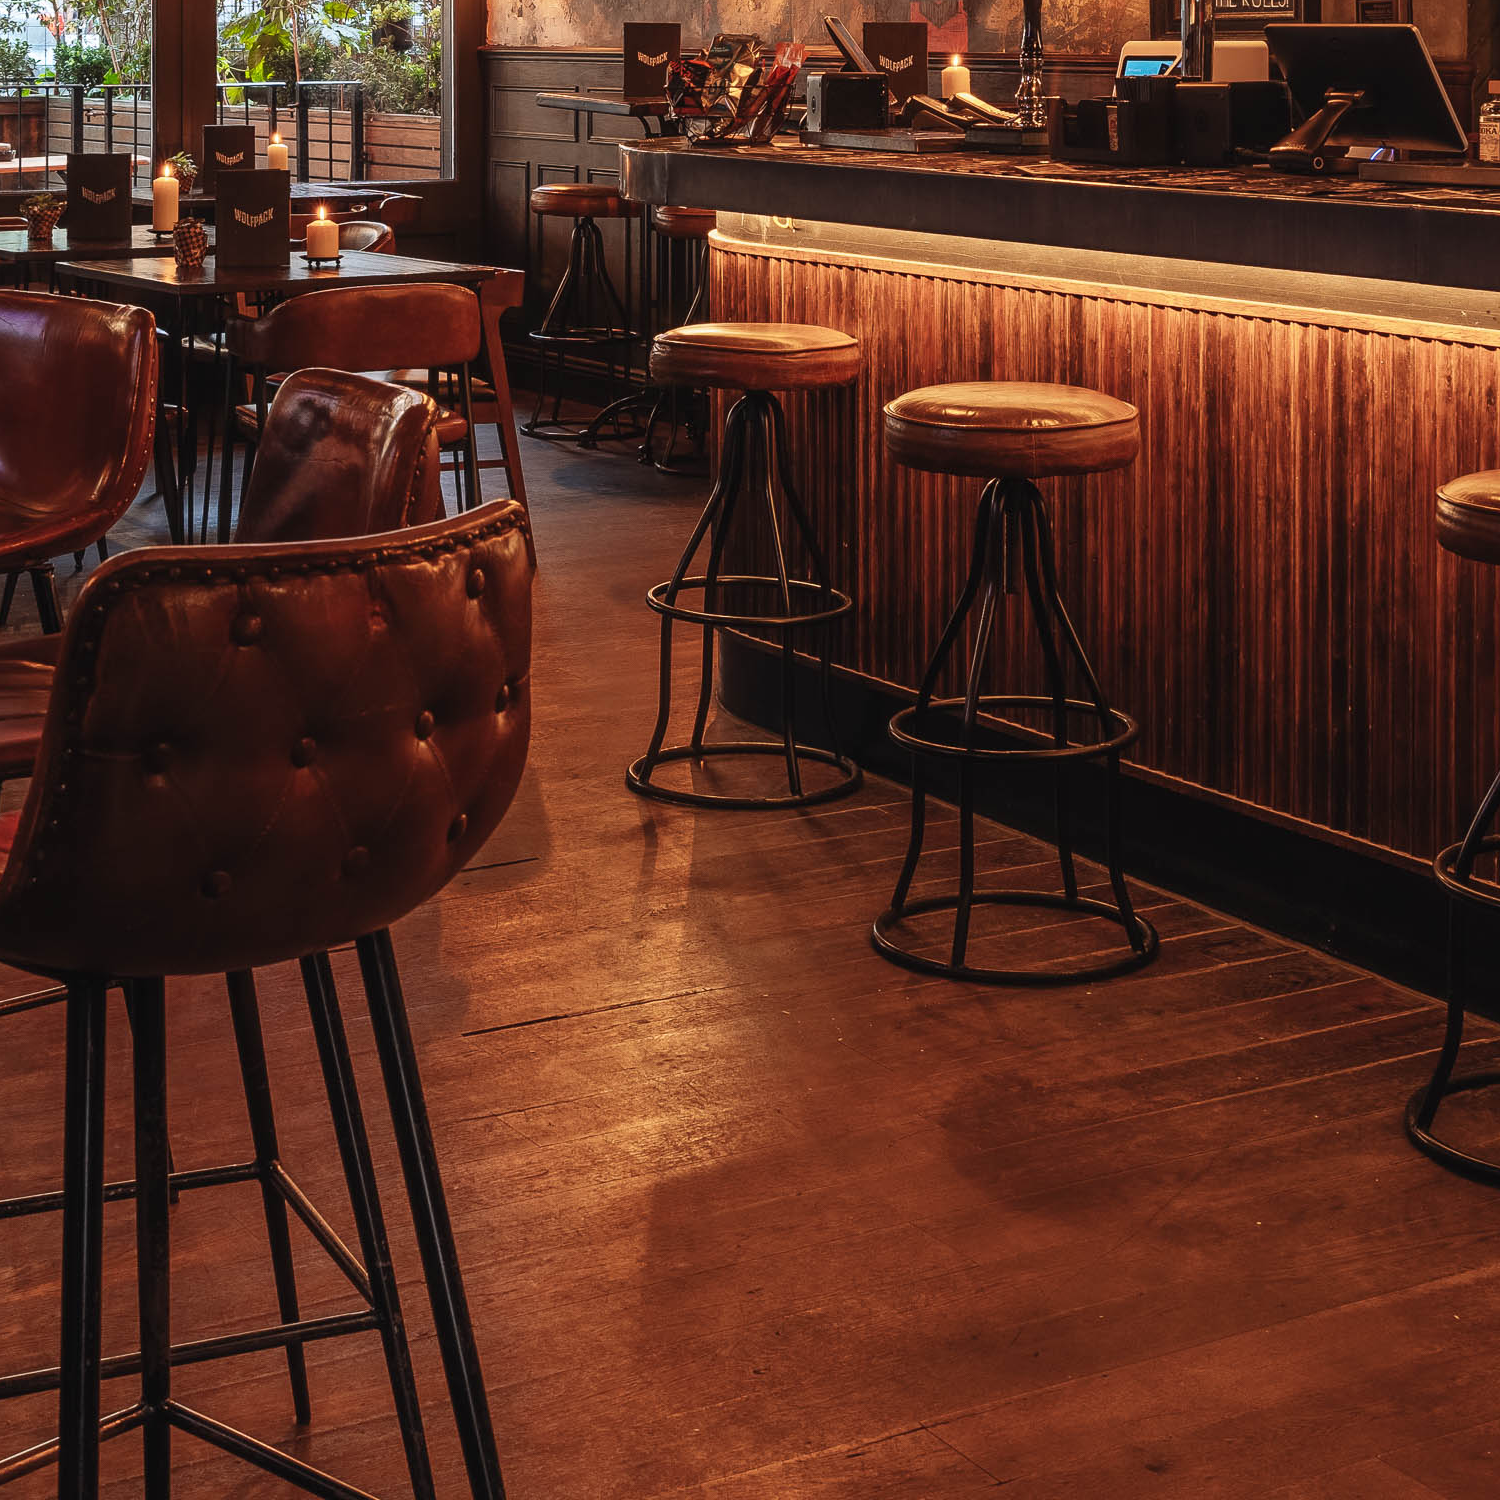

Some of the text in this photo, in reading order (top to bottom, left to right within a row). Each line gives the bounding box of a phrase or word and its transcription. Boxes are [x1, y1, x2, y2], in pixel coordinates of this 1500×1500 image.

[637, 51, 668, 67] WOLFPACK
[879, 54, 914, 73] WOLFPACK
[215, 151, 244, 167] WOLFPACK
[81, 186, 117, 204] WOLFPACK
[233, 207, 274, 228] WOLFPACK
